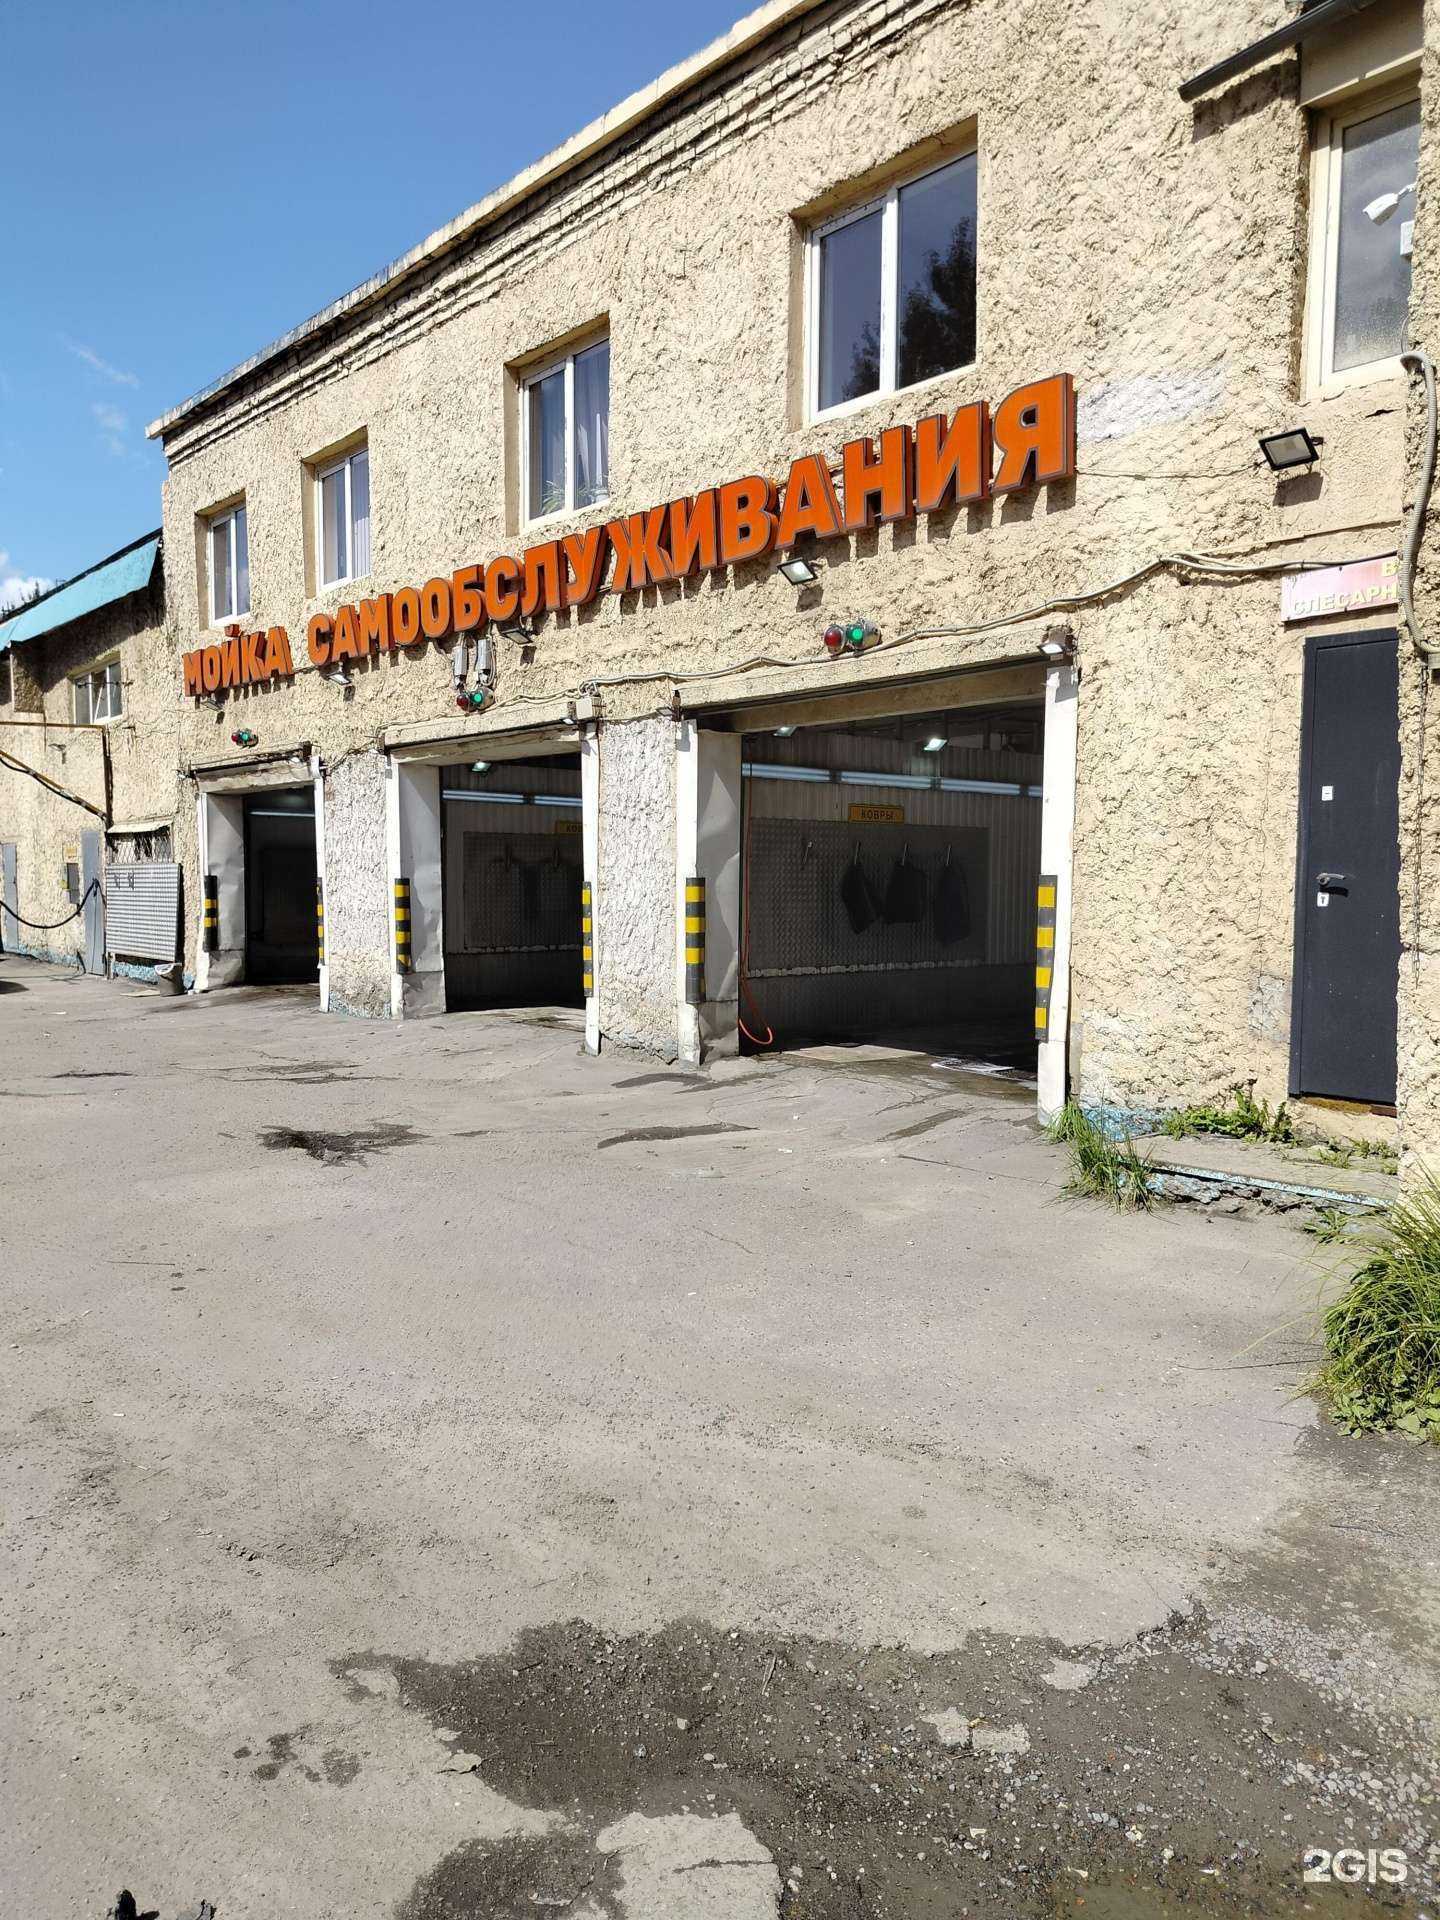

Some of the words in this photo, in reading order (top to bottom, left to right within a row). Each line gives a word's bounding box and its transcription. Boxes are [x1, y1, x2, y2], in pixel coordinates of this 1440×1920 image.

[182, 624, 294, 697] МОЙКА
[307, 373, 1077, 667] САМООБСЛУЖИВАНИЯ
[1293, 583, 1398, 616] СЛЕСАРН
[861, 808, 895, 820] КОВРЫ
[566, 823, 583, 832] КОВ
